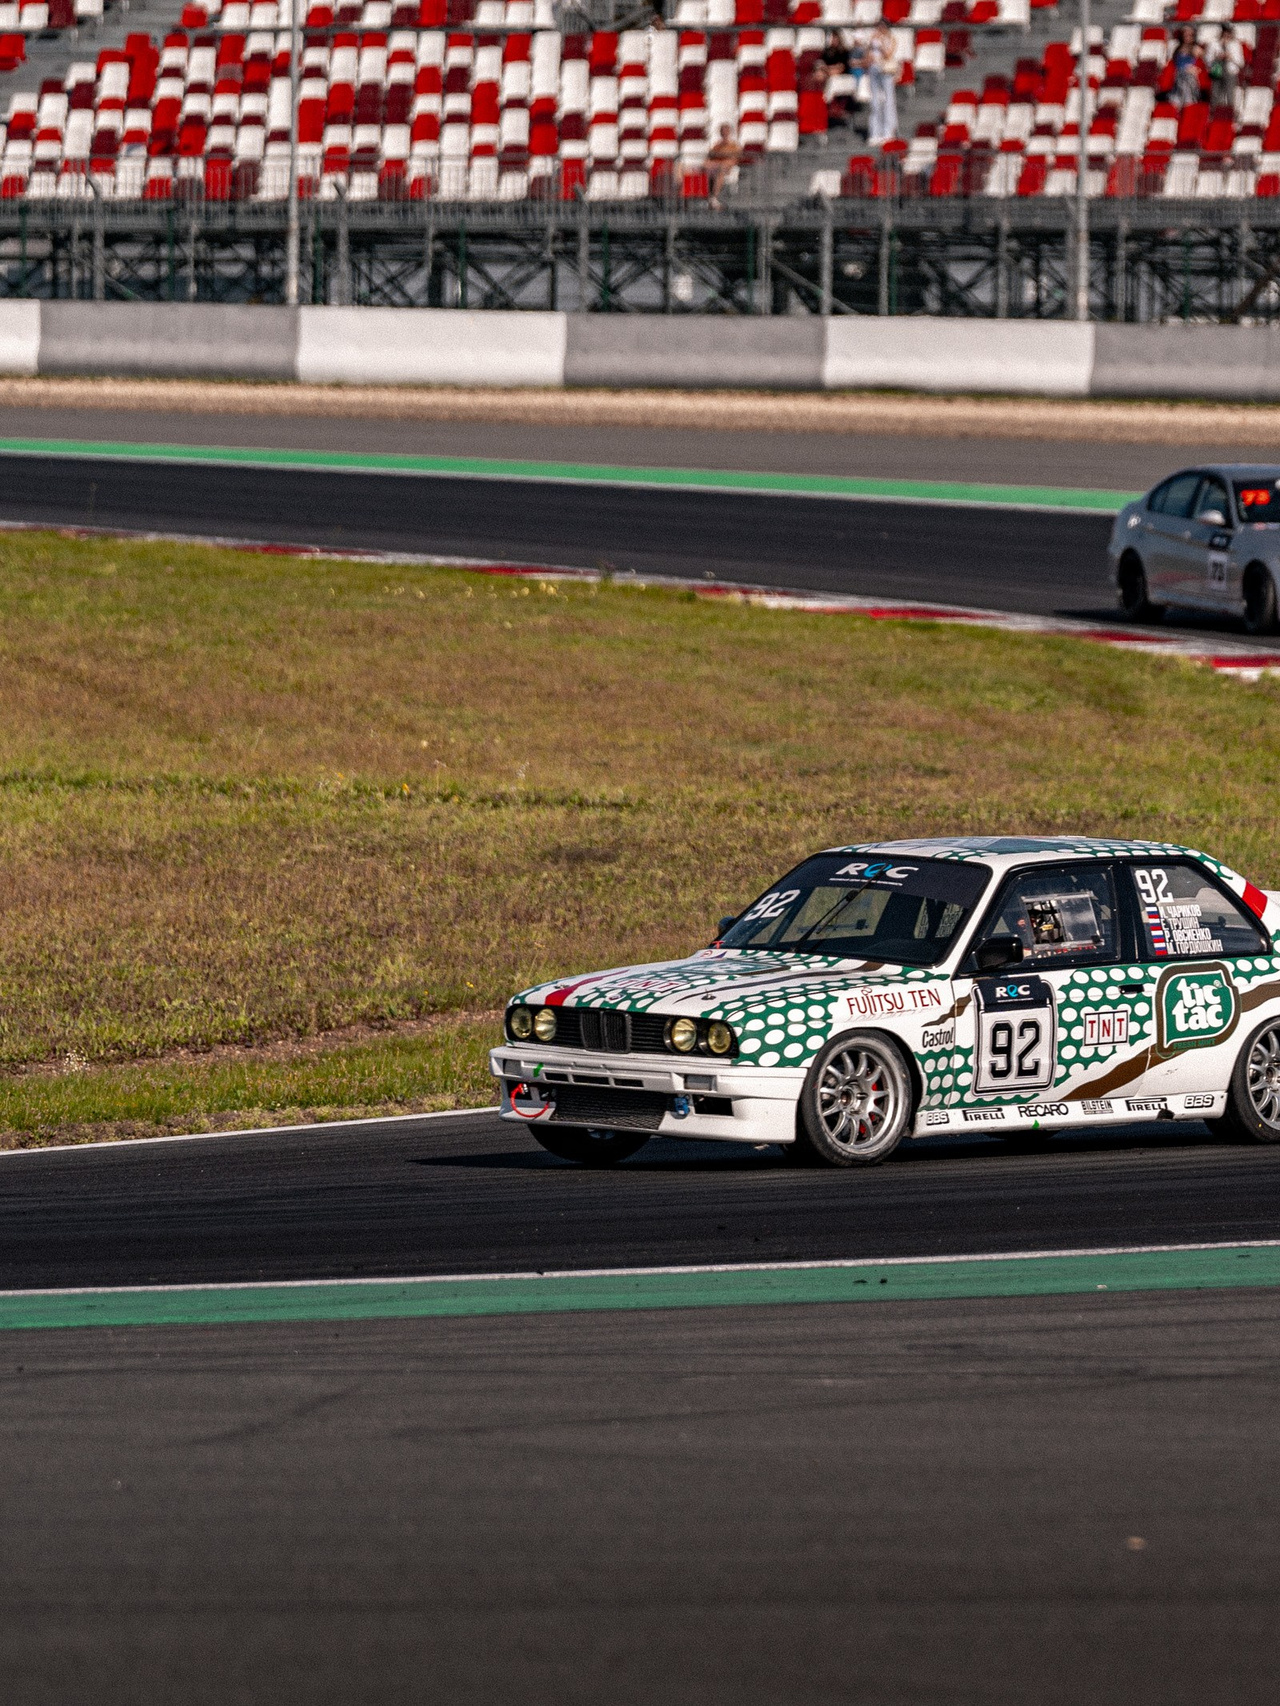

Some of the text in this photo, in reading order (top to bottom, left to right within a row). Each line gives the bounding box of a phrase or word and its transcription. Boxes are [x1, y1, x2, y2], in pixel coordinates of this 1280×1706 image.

[1135, 869, 1174, 903] 92
[744, 889, 801, 921] 92
[1167, 905, 1202, 918] ЧАРИКОВ
[1168, 917, 1200, 930] ТРУШИН
[1164, 928, 1212, 942] Р. ОВСИЕНКО
[1176, 978, 1222, 1008] tic
[846, 986, 942, 1016] FUJITSU TEN
[1171, 1000, 1223, 1032] tac
[1088, 1018, 1125, 1038] TNT
[922, 1027, 954, 1048] Castrol
[989, 1018, 1042, 1081] 92
[1081, 1100, 1113, 1111] BILSTEIN
[1125, 1097, 1168, 1111] PIRELLI
[1184, 1094, 1214, 1109] BBS
[962, 1107, 1005, 1121] PIRELLI
[1018, 1103, 1069, 1117] RECARO
[926, 1111, 950, 1125] BBS
